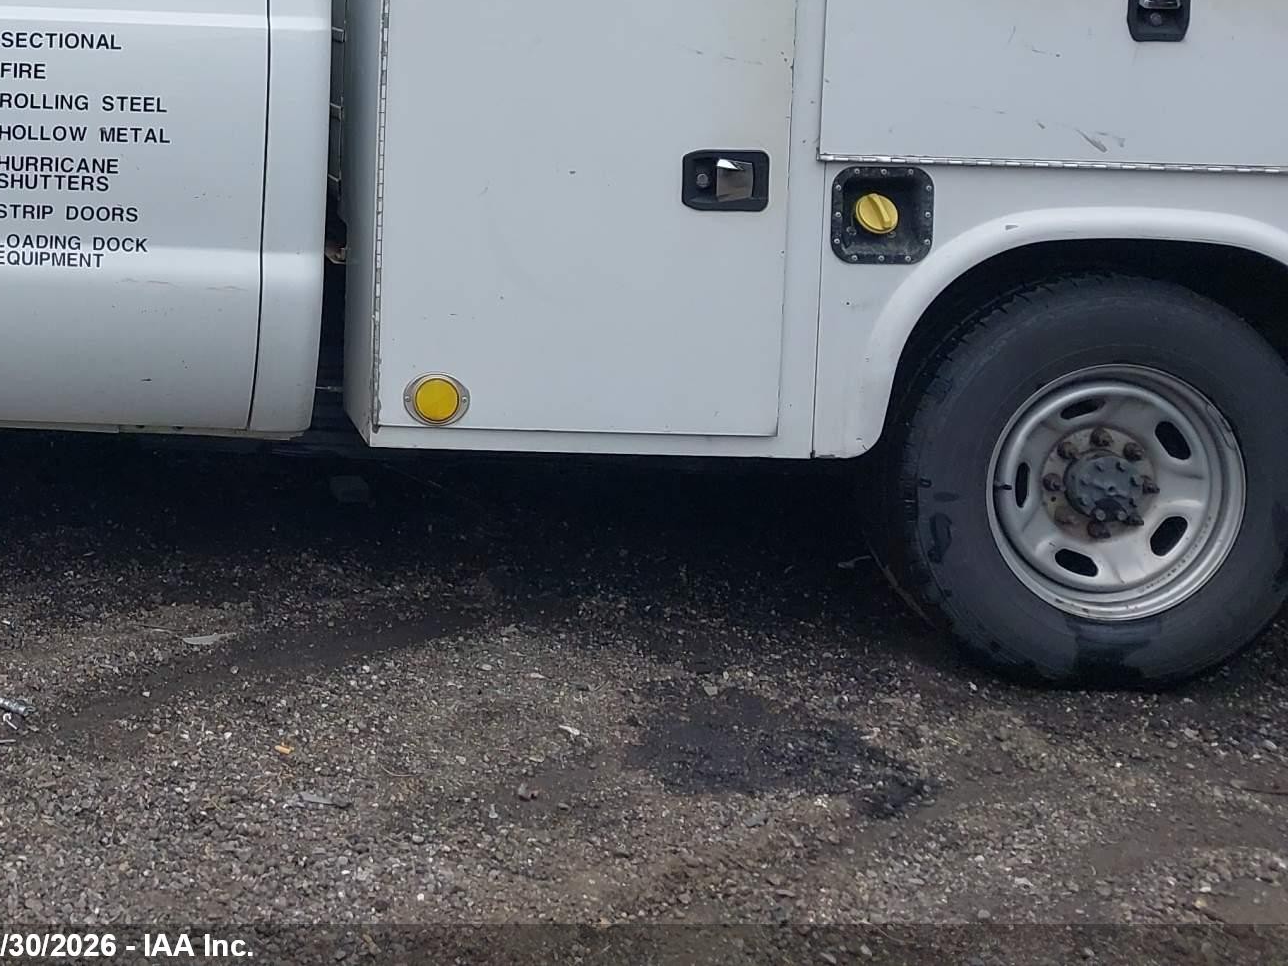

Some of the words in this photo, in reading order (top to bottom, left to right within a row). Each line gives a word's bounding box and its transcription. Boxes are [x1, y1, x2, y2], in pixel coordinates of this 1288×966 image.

[0, 31, 122, 50] SECTIONAL
[0, 62, 47, 80] FIRE
[0, 92, 89, 111] ROLLING
[101, 96, 168, 113] STEEL
[99, 127, 171, 144] METAL
[65, 206, 139, 222] DOORS
[92, 236, 148, 253] DOCK
